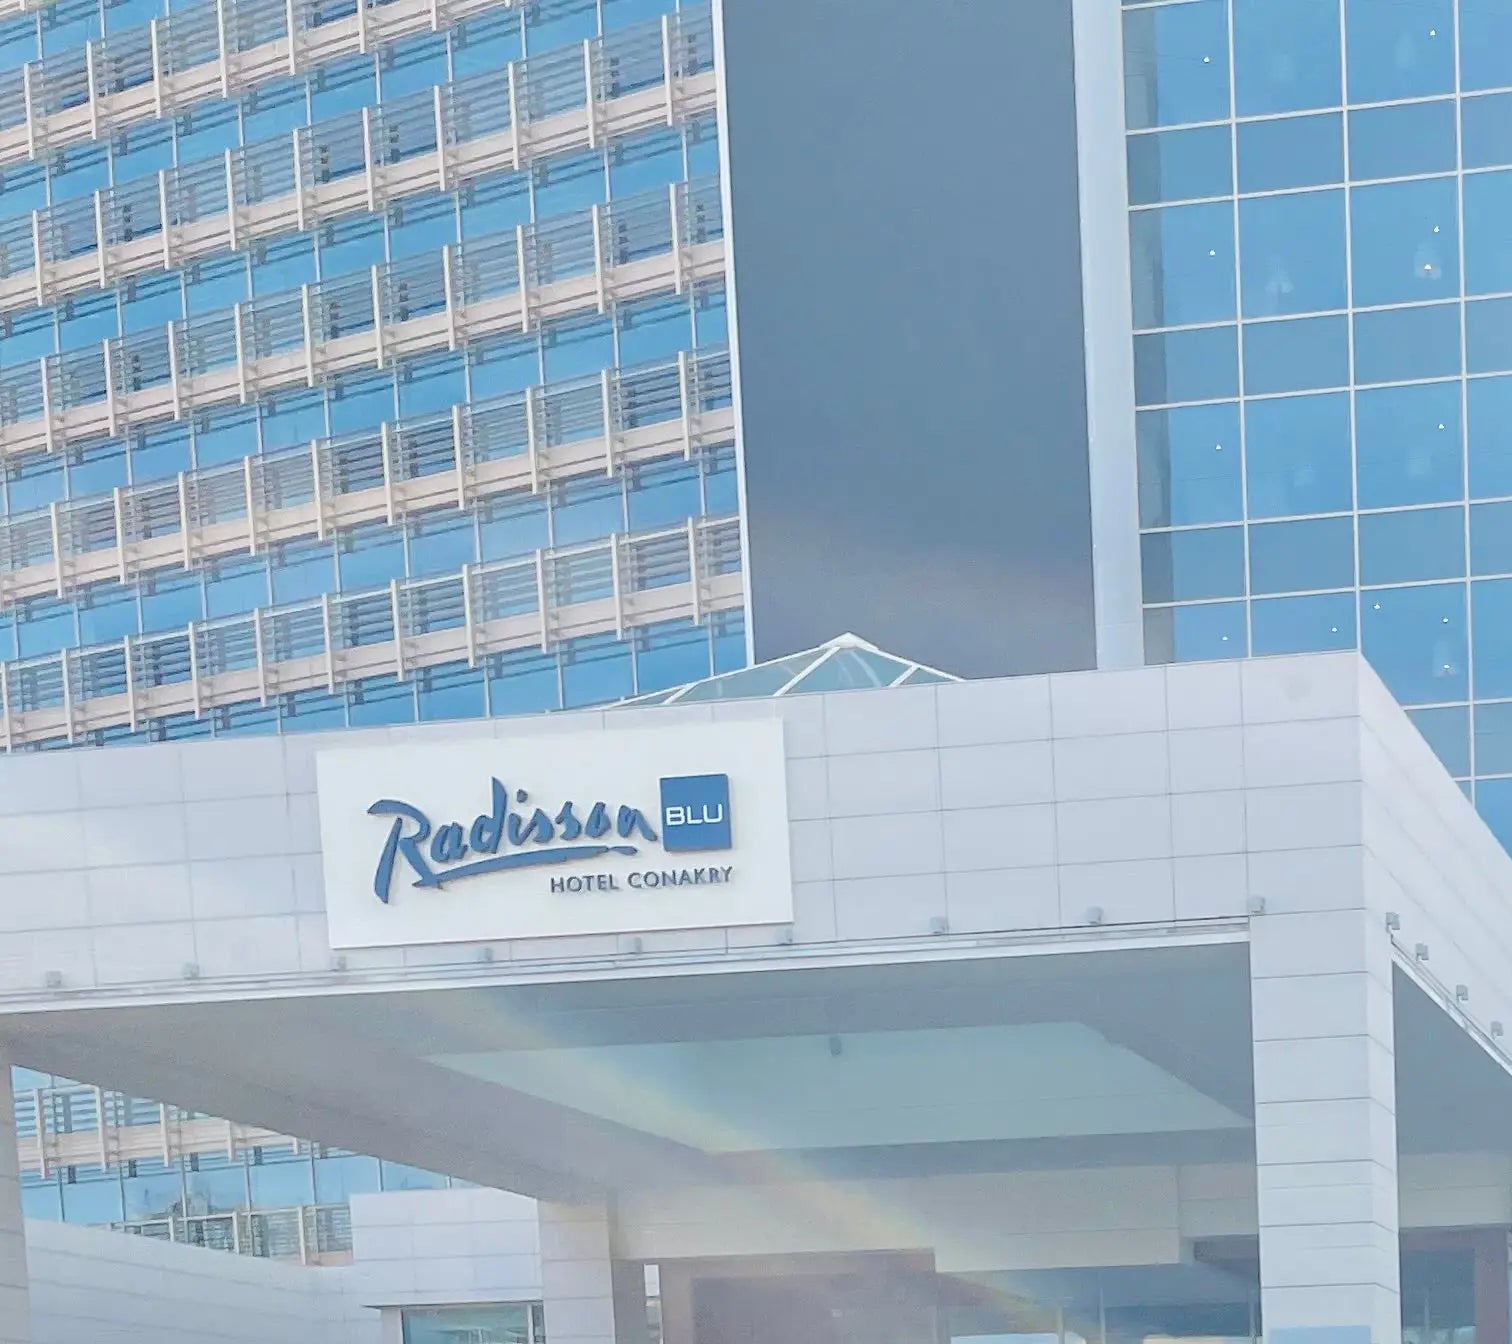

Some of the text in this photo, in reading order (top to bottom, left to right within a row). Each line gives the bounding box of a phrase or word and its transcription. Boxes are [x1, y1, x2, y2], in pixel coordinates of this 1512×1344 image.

[367, 776, 723, 904] Radisson BLU
[551, 866, 733, 893] HOTEL CONAKRY
